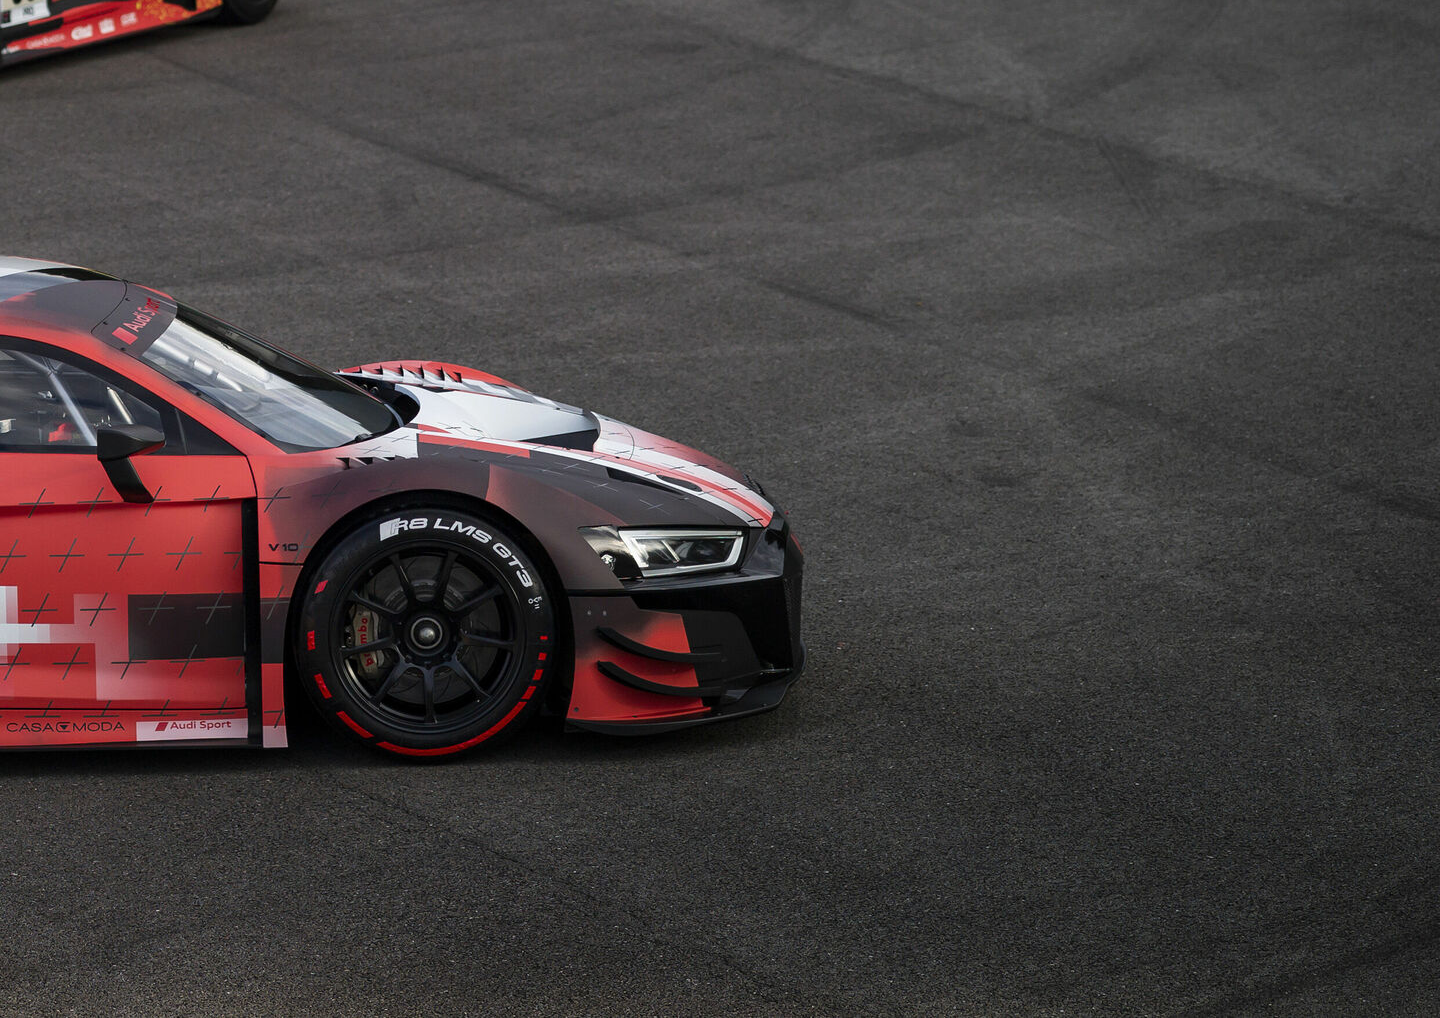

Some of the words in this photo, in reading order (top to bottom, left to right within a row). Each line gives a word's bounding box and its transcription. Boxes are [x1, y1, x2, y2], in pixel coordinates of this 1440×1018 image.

[123, 311, 151, 333] Audi
[387, 517, 428, 537] R8
[433, 518, 493, 544] LMS
[492, 542, 534, 589] GT3
[357, 617, 374, 666] brmbo
[170, 720, 197, 730] Audi
[199, 720, 233, 731] Sport
